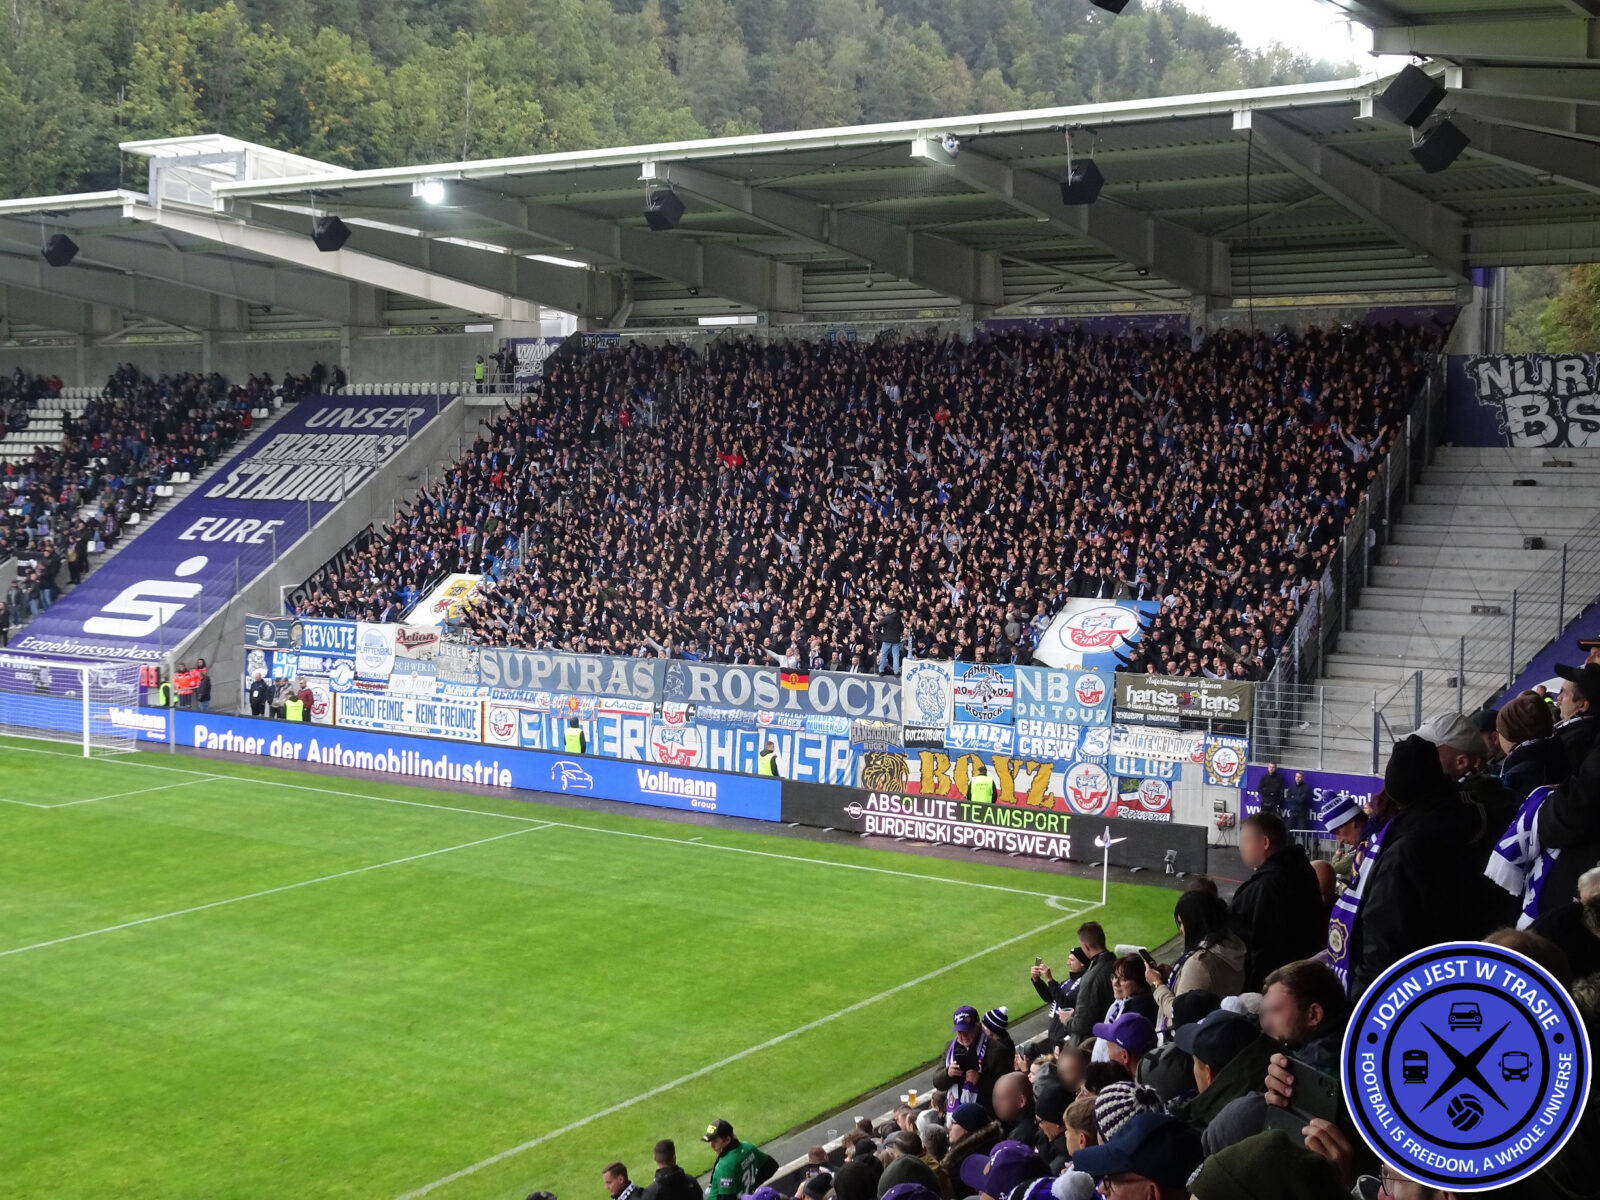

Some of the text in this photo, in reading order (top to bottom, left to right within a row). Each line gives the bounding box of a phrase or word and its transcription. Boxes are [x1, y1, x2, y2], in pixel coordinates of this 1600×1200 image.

[305, 407, 427, 428] UNSER
[204, 463, 373, 502] STADION
[177, 517, 285, 544] EURE
[304, 624, 357, 650] REVOLTE
[395, 661, 438, 673] SCHWERIN
[480, 647, 655, 700] SUPTRAS
[963, 664, 1004, 684] FANATICS
[604, 699, 644, 711] LAAGE
[688, 665, 902, 722] ROSTOCK
[1126, 684, 1179, 707] hansa
[1200, 689, 1241, 713] fans
[340, 695, 375, 719] TAUSEND
[377, 699, 405, 723] FEINDE
[416, 702, 437, 726] KEINE
[440, 705, 477, 730] FREUNDE
[965, 703, 1003, 720] ROSTOCK
[1051, 706, 1107, 724] TOUR
[950, 724, 1012, 745] WAREN
[1017, 718, 1080, 742] CHAOS
[1206, 736, 1249, 748] ALTMARK
[194, 724, 513, 788] Partner der Automobilindustrie
[1018, 737, 1078, 761] CREW
[637, 768, 717, 797] Vollmann
[918, 750, 1055, 809] BOYZ
[691, 799, 717, 810] Group
[866, 792, 957, 820] ABSOLUTE
[960, 803, 1072, 833] TEAMSPORT
[865, 815, 1071, 858] BURDENSKI SPORTSWEAR
